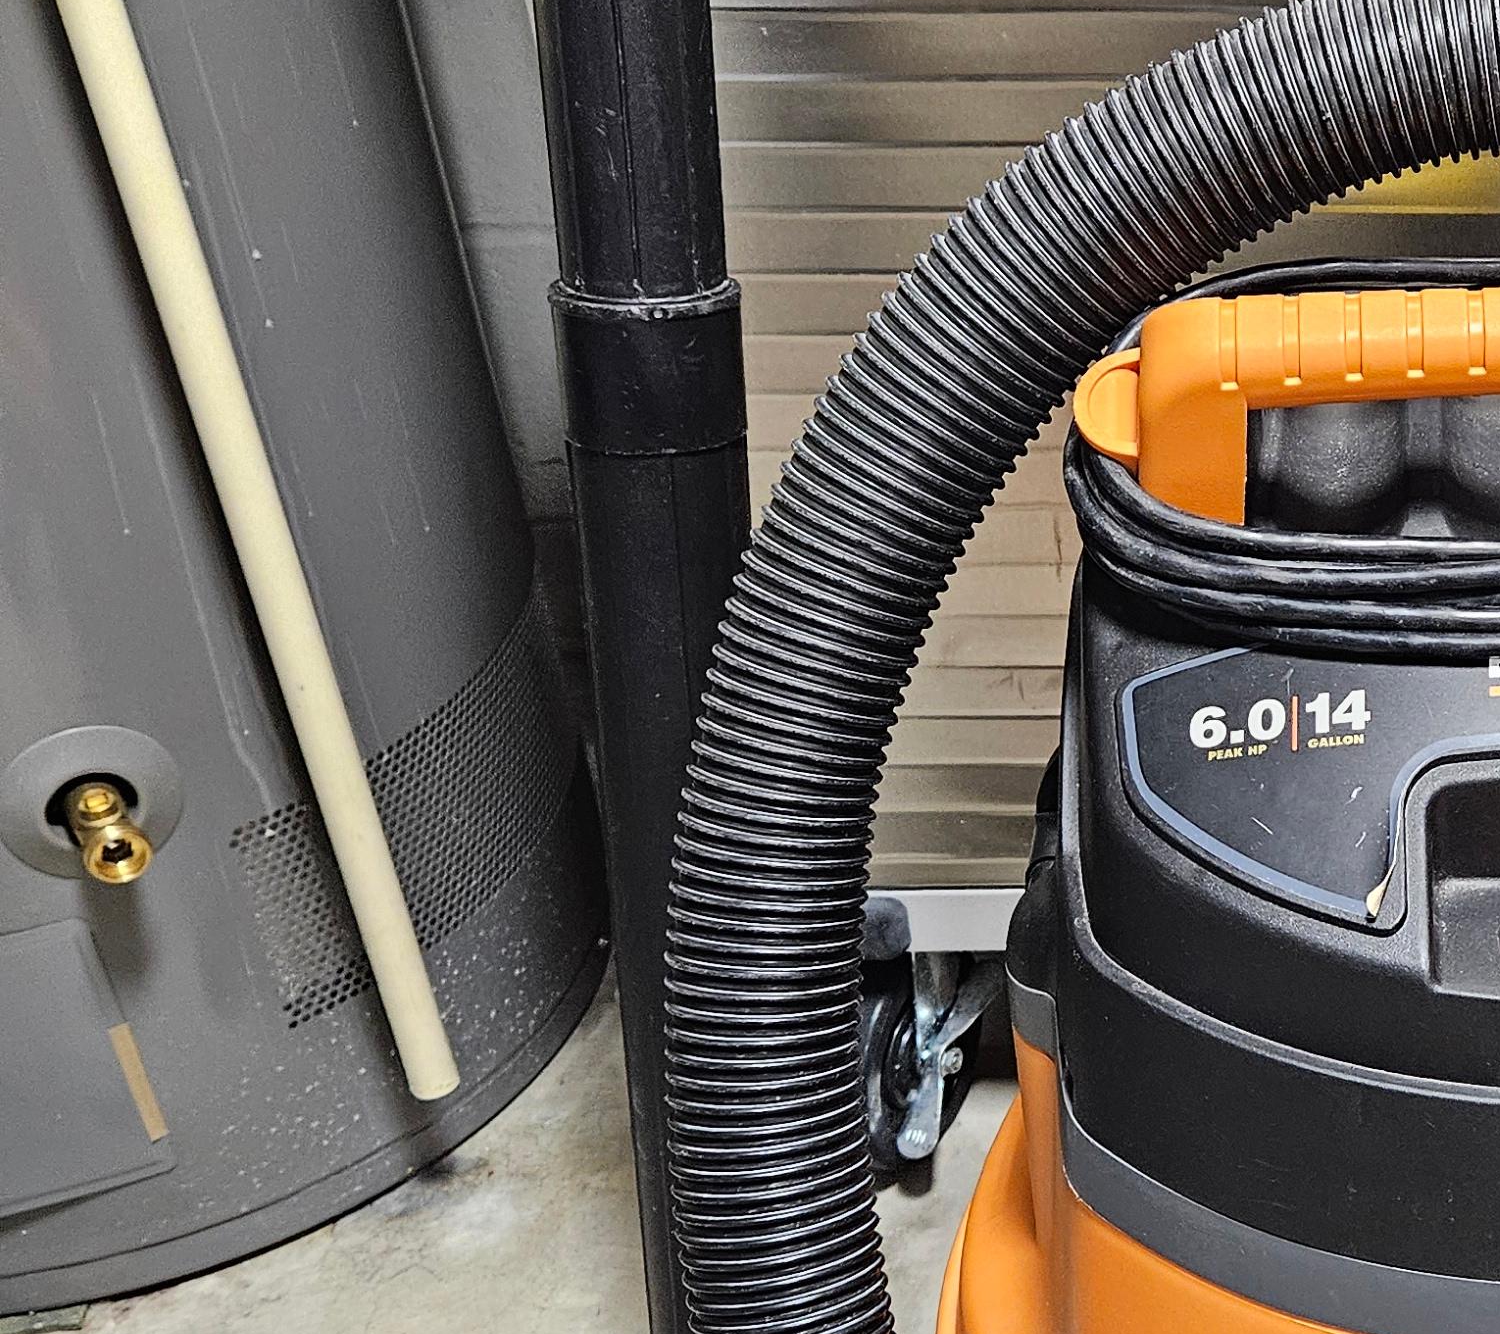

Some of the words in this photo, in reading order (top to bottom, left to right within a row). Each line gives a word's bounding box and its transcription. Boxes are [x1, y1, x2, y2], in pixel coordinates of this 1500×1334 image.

[1189, 698, 1286, 749] 6.0
[1305, 689, 1371, 734] 14
[1207, 746, 1243, 762] PEAK
[1307, 734, 1365, 749] GALLON
